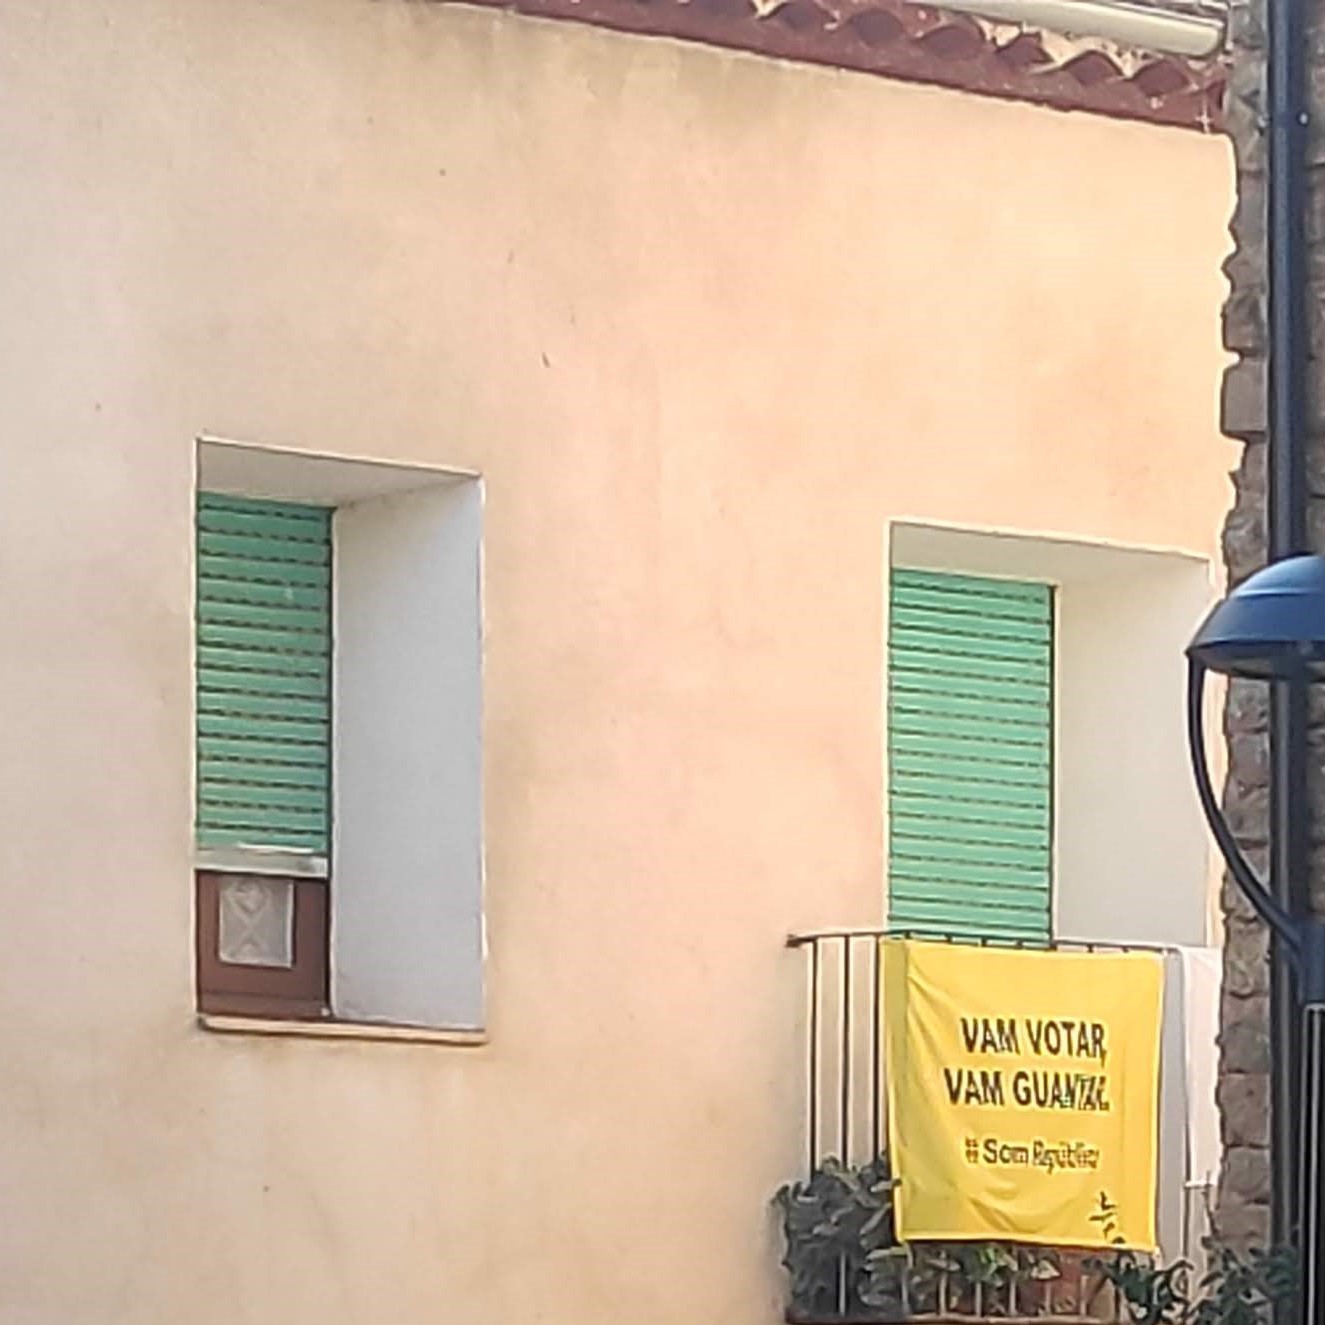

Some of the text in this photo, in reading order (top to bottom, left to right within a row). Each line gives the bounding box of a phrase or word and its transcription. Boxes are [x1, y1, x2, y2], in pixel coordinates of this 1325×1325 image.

[960, 1017, 1107, 1068] VAM VOTAR,
[943, 1067, 1005, 1107] VAM
